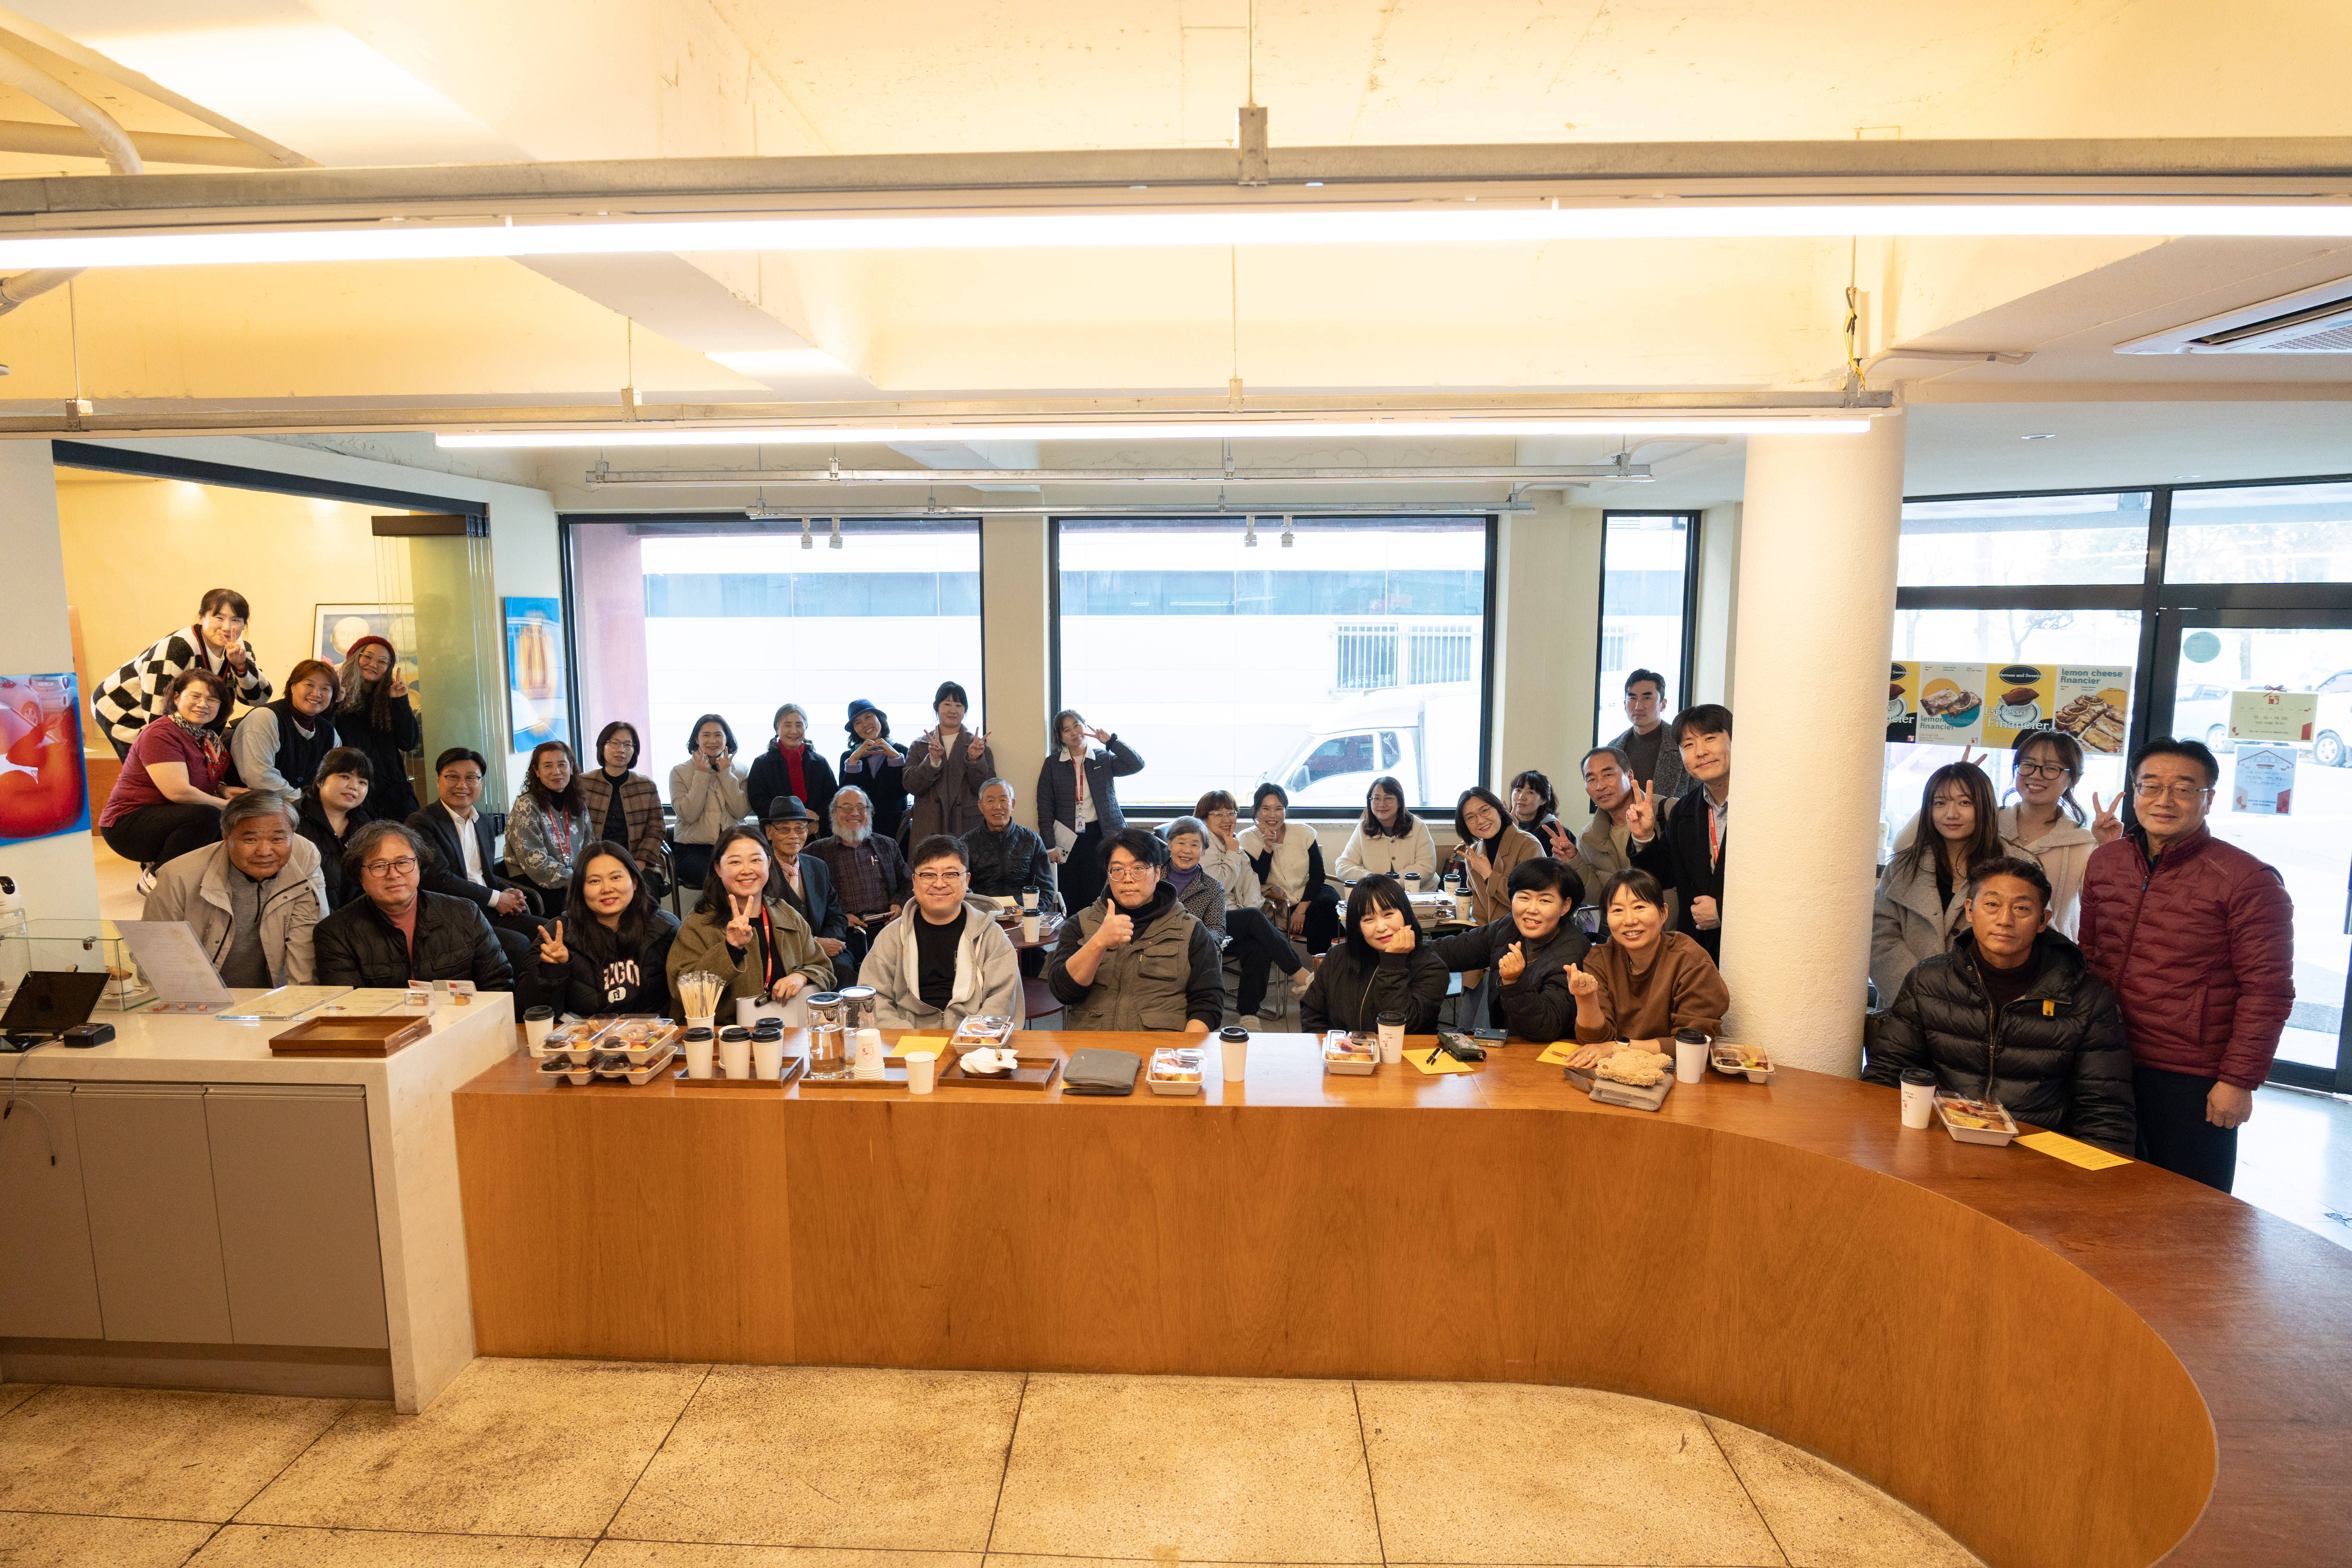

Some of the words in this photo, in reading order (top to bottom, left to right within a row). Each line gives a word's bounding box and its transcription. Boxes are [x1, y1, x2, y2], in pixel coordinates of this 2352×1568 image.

[2060, 676, 2101, 684] financier
[1985, 706, 2026, 716] Espresso
[1887, 714, 1915, 723] ncier
[1987, 717, 2050, 730] Financier
